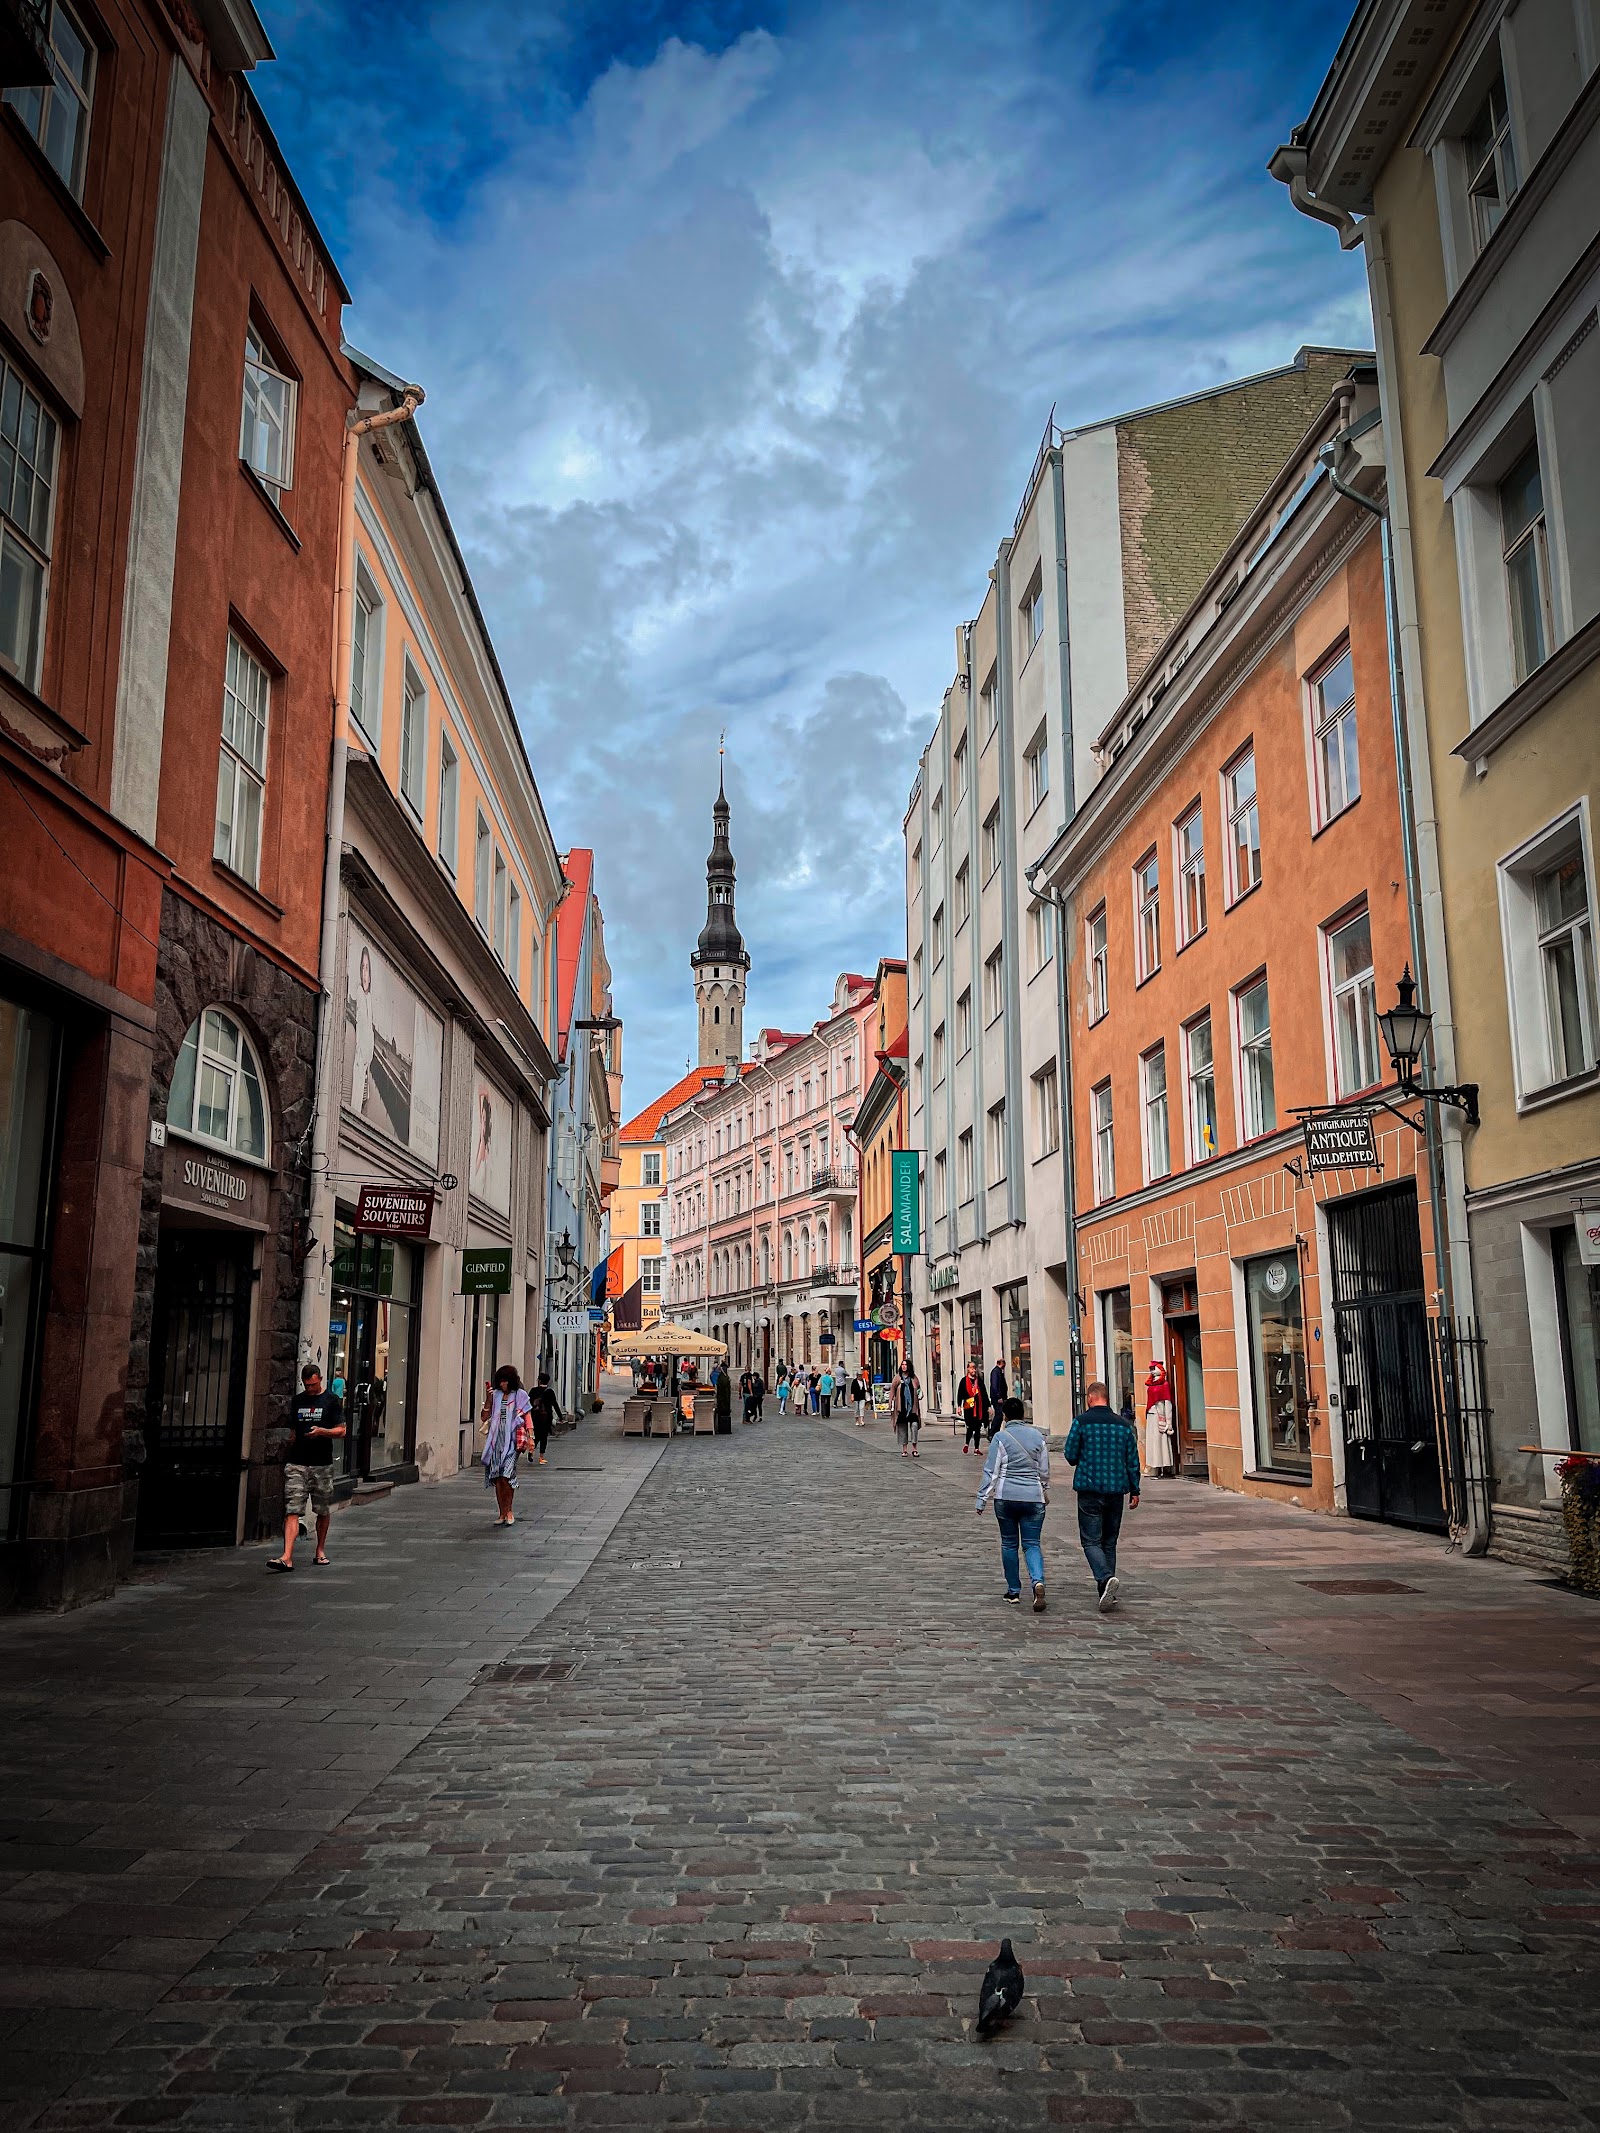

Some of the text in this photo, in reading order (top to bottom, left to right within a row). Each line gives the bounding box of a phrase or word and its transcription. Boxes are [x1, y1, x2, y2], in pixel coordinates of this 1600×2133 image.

[154, 1127, 162, 1140] 12
[1310, 1131, 1368, 1149] ANTIQUE
[206, 1155, 230, 1170] KAUPLUS
[1311, 1150, 1374, 1165] KULDEHTED
[183, 1160, 247, 1201] SUVENIIRID
[201, 1192, 229, 1208] SOUVENIRS
[364, 1196, 427, 1211] SUVENIIRID
[900, 1161, 911, 1245] SALAMANDER
[362, 1210, 425, 1225] SOUVENIRS
[465, 1262, 506, 1273] GLENFIELD
[556, 1315, 583, 1325] CRU
